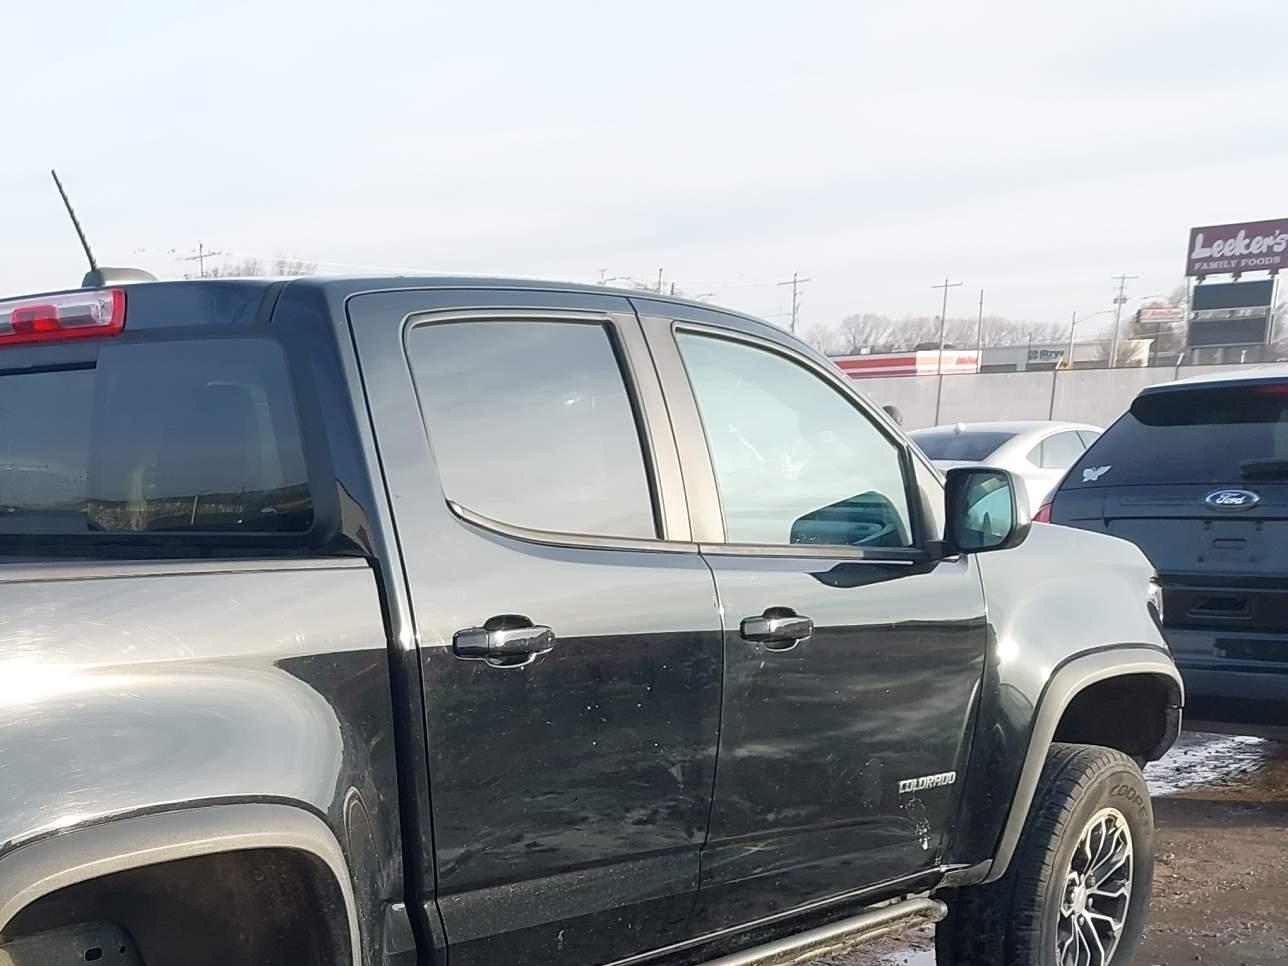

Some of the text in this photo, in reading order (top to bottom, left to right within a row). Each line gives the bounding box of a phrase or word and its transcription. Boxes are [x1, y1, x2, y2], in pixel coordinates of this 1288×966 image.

[1191, 229, 1288, 259] Leeker's
[1194, 256, 1281, 270] FAMILY FOODS
[1216, 492, 1247, 504] Ford
[899, 771, 956, 794] COLORADO
